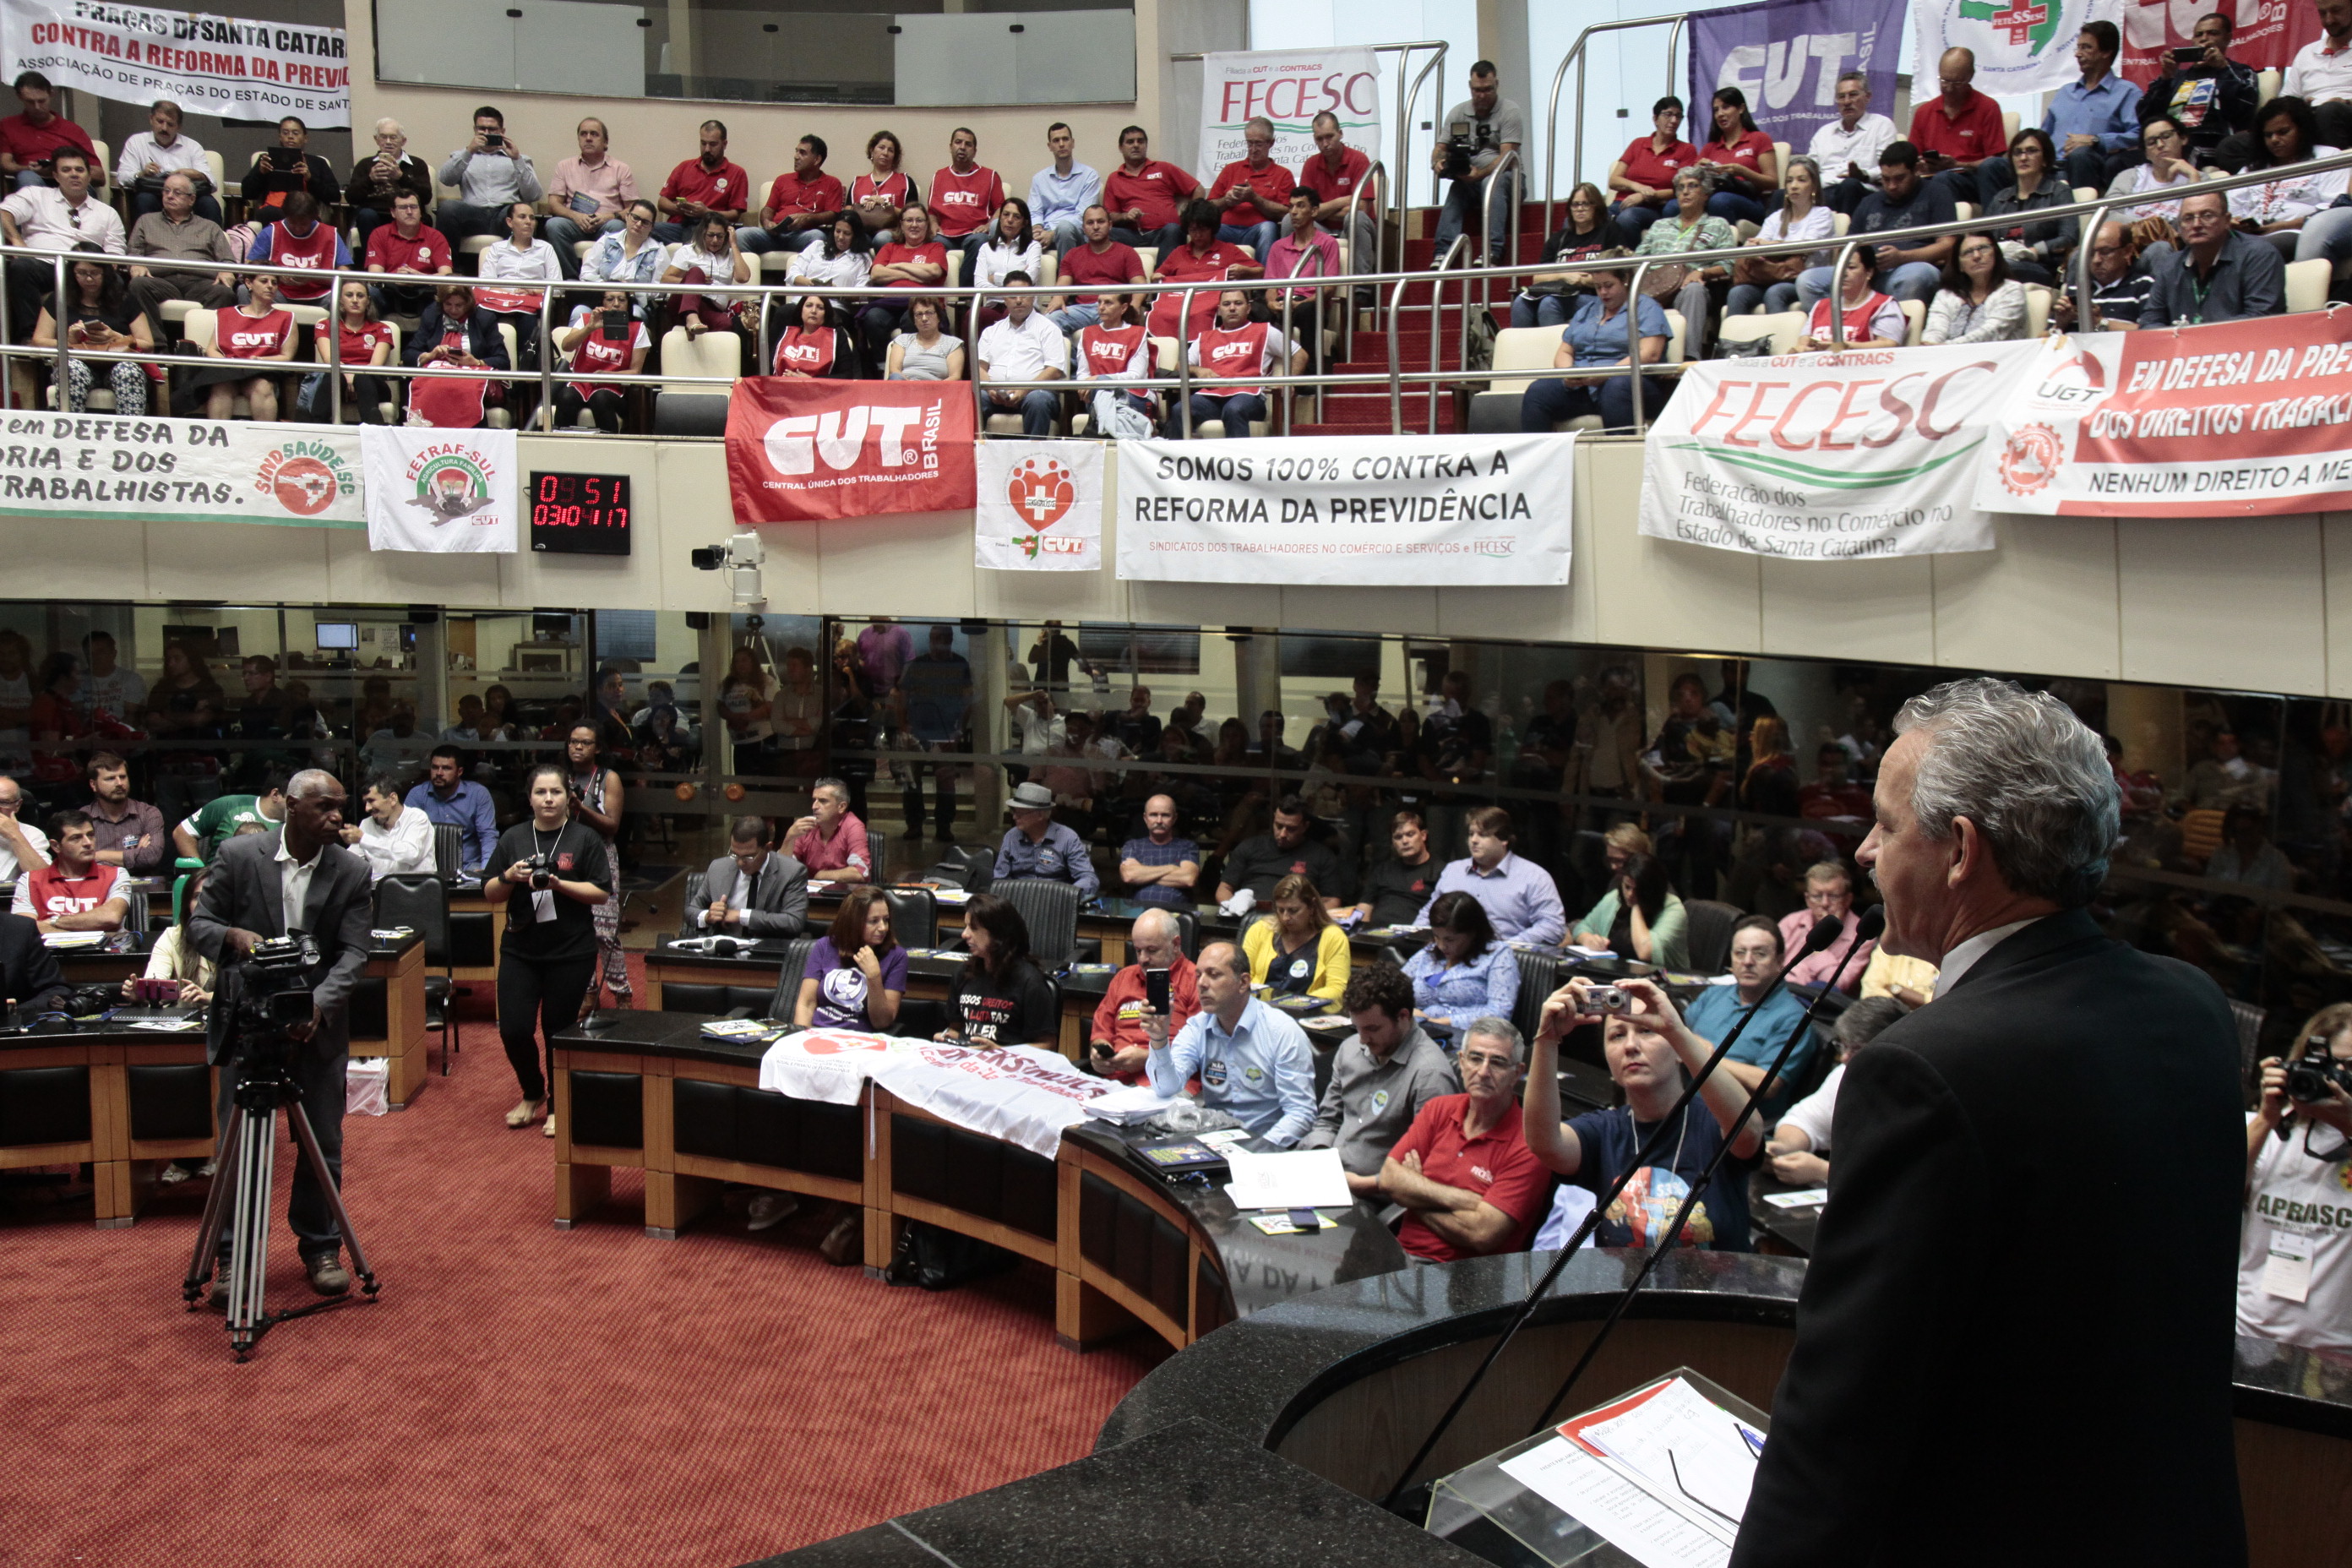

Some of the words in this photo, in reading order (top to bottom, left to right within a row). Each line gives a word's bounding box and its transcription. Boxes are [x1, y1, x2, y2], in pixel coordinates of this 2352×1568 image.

[75, 1, 167, 35] PRAÇAS
[200, 20, 270, 49] SANTA
[275, 30, 347, 59] CATAR
[31, 22, 121, 57] CONTRA
[125, 39, 141, 63] A
[147, 43, 246, 76] REFORMA
[252, 56, 280, 82] DA
[1717, 32, 1857, 112] CUT
[1858, 21, 1877, 74] ASIL
[17, 56, 113, 80] ASSOCIAÇÃO
[118, 72, 139, 85] DE
[144, 78, 204, 96] PRAÇAS
[210, 87, 230, 99] DO
[235, 90, 290, 106] ESTADO
[296, 98, 314, 110] DE
[318, 100, 351, 112] SANT
[1220, 72, 1375, 123] FECESC
[944, 192, 975, 204] CUT
[281, 253, 318, 269] CUT
[231, 333, 275, 346] CUT
[586, 341, 621, 362] CUT
[785, 346, 816, 359] CUT
[1092, 341, 1124, 357] CUT
[1212, 343, 1250, 359] CUT
[1771, 355, 1796, 368] CUT
[1817, 351, 1895, 367] CONTRACS
[2126, 359, 2165, 395] EM
[2161, 350, 2255, 391] DEFESA
[2255, 347, 2295, 384] DA
[2037, 381, 2103, 402] UGT
[1690, 361, 1999, 452] FECESC
[8, 418, 46, 435] em
[52, 418, 174, 445] DEFESA
[188, 425, 230, 448] DA
[922, 398, 942, 469] BRASIL
[2088, 408, 2139, 440] DOS
[2138, 402, 2253, 438] DIREITOS
[764, 406, 921, 475] CUT
[0, 446, 63, 471] RIA
[78, 449, 96, 471] E
[112, 449, 177, 473] DOS
[406, 443, 497, 482] FETRAF-SUL
[420, 459, 459, 484] AGRICULTURA
[459, 460, 483, 484] FAMILIAR
[1157, 456, 1254, 482] SOMOS
[1266, 457, 1340, 482] 100%
[1353, 453, 1478, 480] CONTRA
[1489, 449, 1509, 476] A
[763, 481, 806, 490] CENTRAL
[808, 478, 836, 489] ÚNICA
[838, 476, 857, 486] DOS
[859, 470, 939, 482] TRABALHADORES
[1684, 471, 1770, 505] Federação
[1774, 485, 1806, 507] dos
[2088, 471, 2188, 493] NENHUM
[2194, 467, 2289, 493] DIREITO
[2293, 466, 2311, 487] A
[1135, 497, 1269, 523] REFORMA
[1281, 498, 1319, 523] DA
[1331, 487, 1532, 523] PREVIDÊNCIA
[1679, 495, 1802, 533] Trabalhadores
[1808, 516, 1831, 531] no
[1838, 505, 1925, 532] Comércio
[1929, 504, 1953, 522] no
[471, 515, 498, 525] CUT
[1043, 537, 1082, 553] CUT
[1149, 542, 1204, 552] SINDICATOS
[1207, 542, 1228, 553] DOS
[1231, 542, 1319, 553] TRABALHADORES
[1322, 544, 1336, 553] NO
[1340, 542, 1392, 554] COMÉRCIO
[1396, 544, 1402, 553] E
[1406, 542, 1460, 555] SERVIÇOS
[1463, 545, 1469, 553] e
[1473, 541, 1516, 553] FECESC
[1676, 519, 1734, 547] Estado
[1738, 531, 1757, 550] de
[1762, 536, 1815, 558] Santa
[1821, 535, 1897, 558] Catarina
[47, 896, 98, 913] CUT
[960, 994, 982, 1004] OSSOS
[983, 996, 1014, 1010] DIREITOS
[991, 1012, 1010, 1023] FAZ
[2257, 1194, 2352, 1228] APRASC
